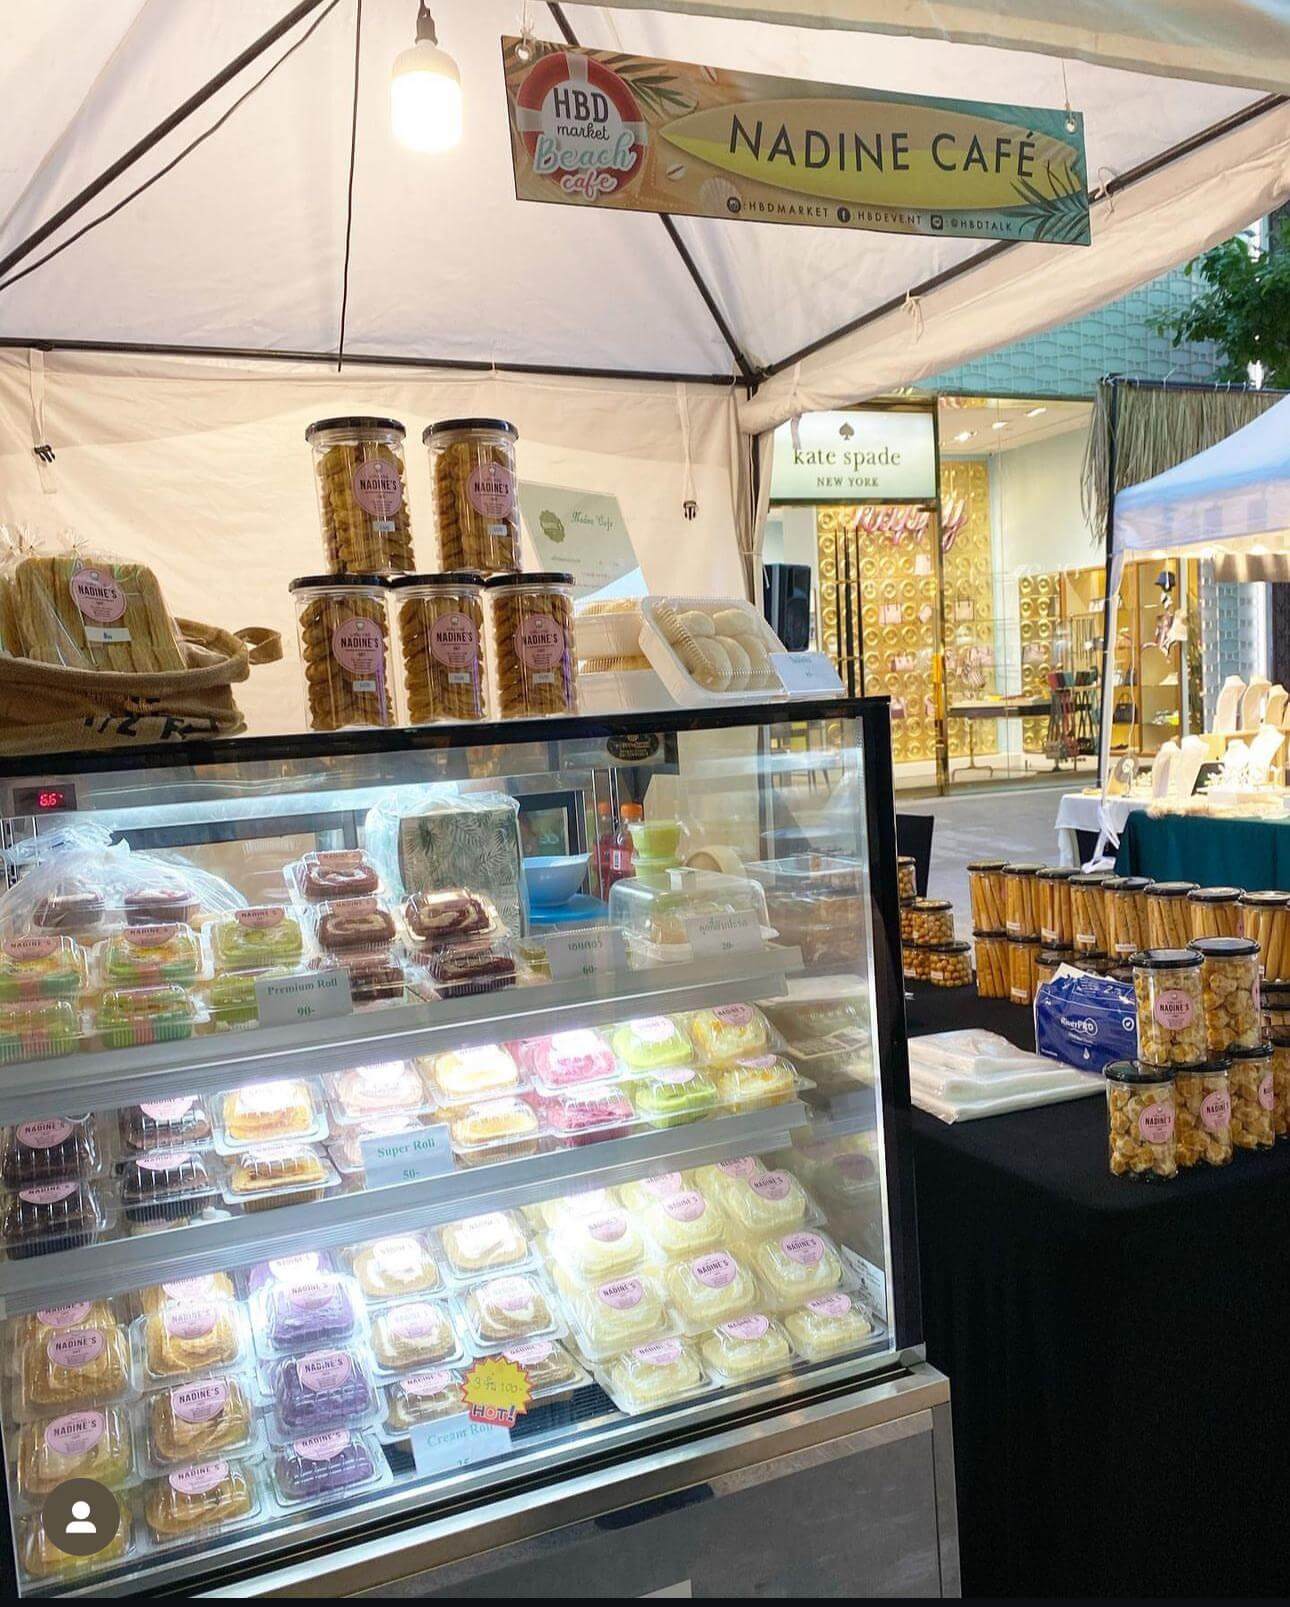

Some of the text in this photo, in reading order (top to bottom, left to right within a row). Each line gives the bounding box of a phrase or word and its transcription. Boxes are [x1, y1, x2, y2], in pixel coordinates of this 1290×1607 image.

[553, 87, 609, 123] HBD
[556, 122, 610, 141] market
[534, 131, 637, 172] Beach
[729, 113, 1036, 178] NADINE CAFÉ
[561, 170, 618, 199] cafe
[793, 446, 902, 472] kate spade
[360, 479, 397, 490] NADINE'S
[474, 482, 509, 494] NADINE'S
[816, 477, 880, 488] NEW YORK
[78, 584, 117, 599] NADINE'S
[340, 637, 379, 649] NADINE'S
[436, 632, 473, 643] NADINE'S
[267, 978, 338, 995] Premium Roll
[377, 1138, 436, 1158] Super Roll
[753, 1176, 784, 1188] NADINE'S
[787, 1239, 817, 1251] NADINE'S
[697, 1259, 729, 1274] NADINE'S
[602, 1282, 637, 1297] NADINE'S
[55, 1336, 97, 1350] NADINE'S
[304, 1359, 343, 1373] NADINE'S
[178, 1386, 220, 1404] NADINE'S
[472, 1404, 515, 1421] HOT!
[53, 1420, 97, 1437] NADINE'S
[302, 1431, 342, 1447] NADINE'S
[426, 1430, 466, 1448] Cream
[178, 1464, 220, 1480] NADINE'S
